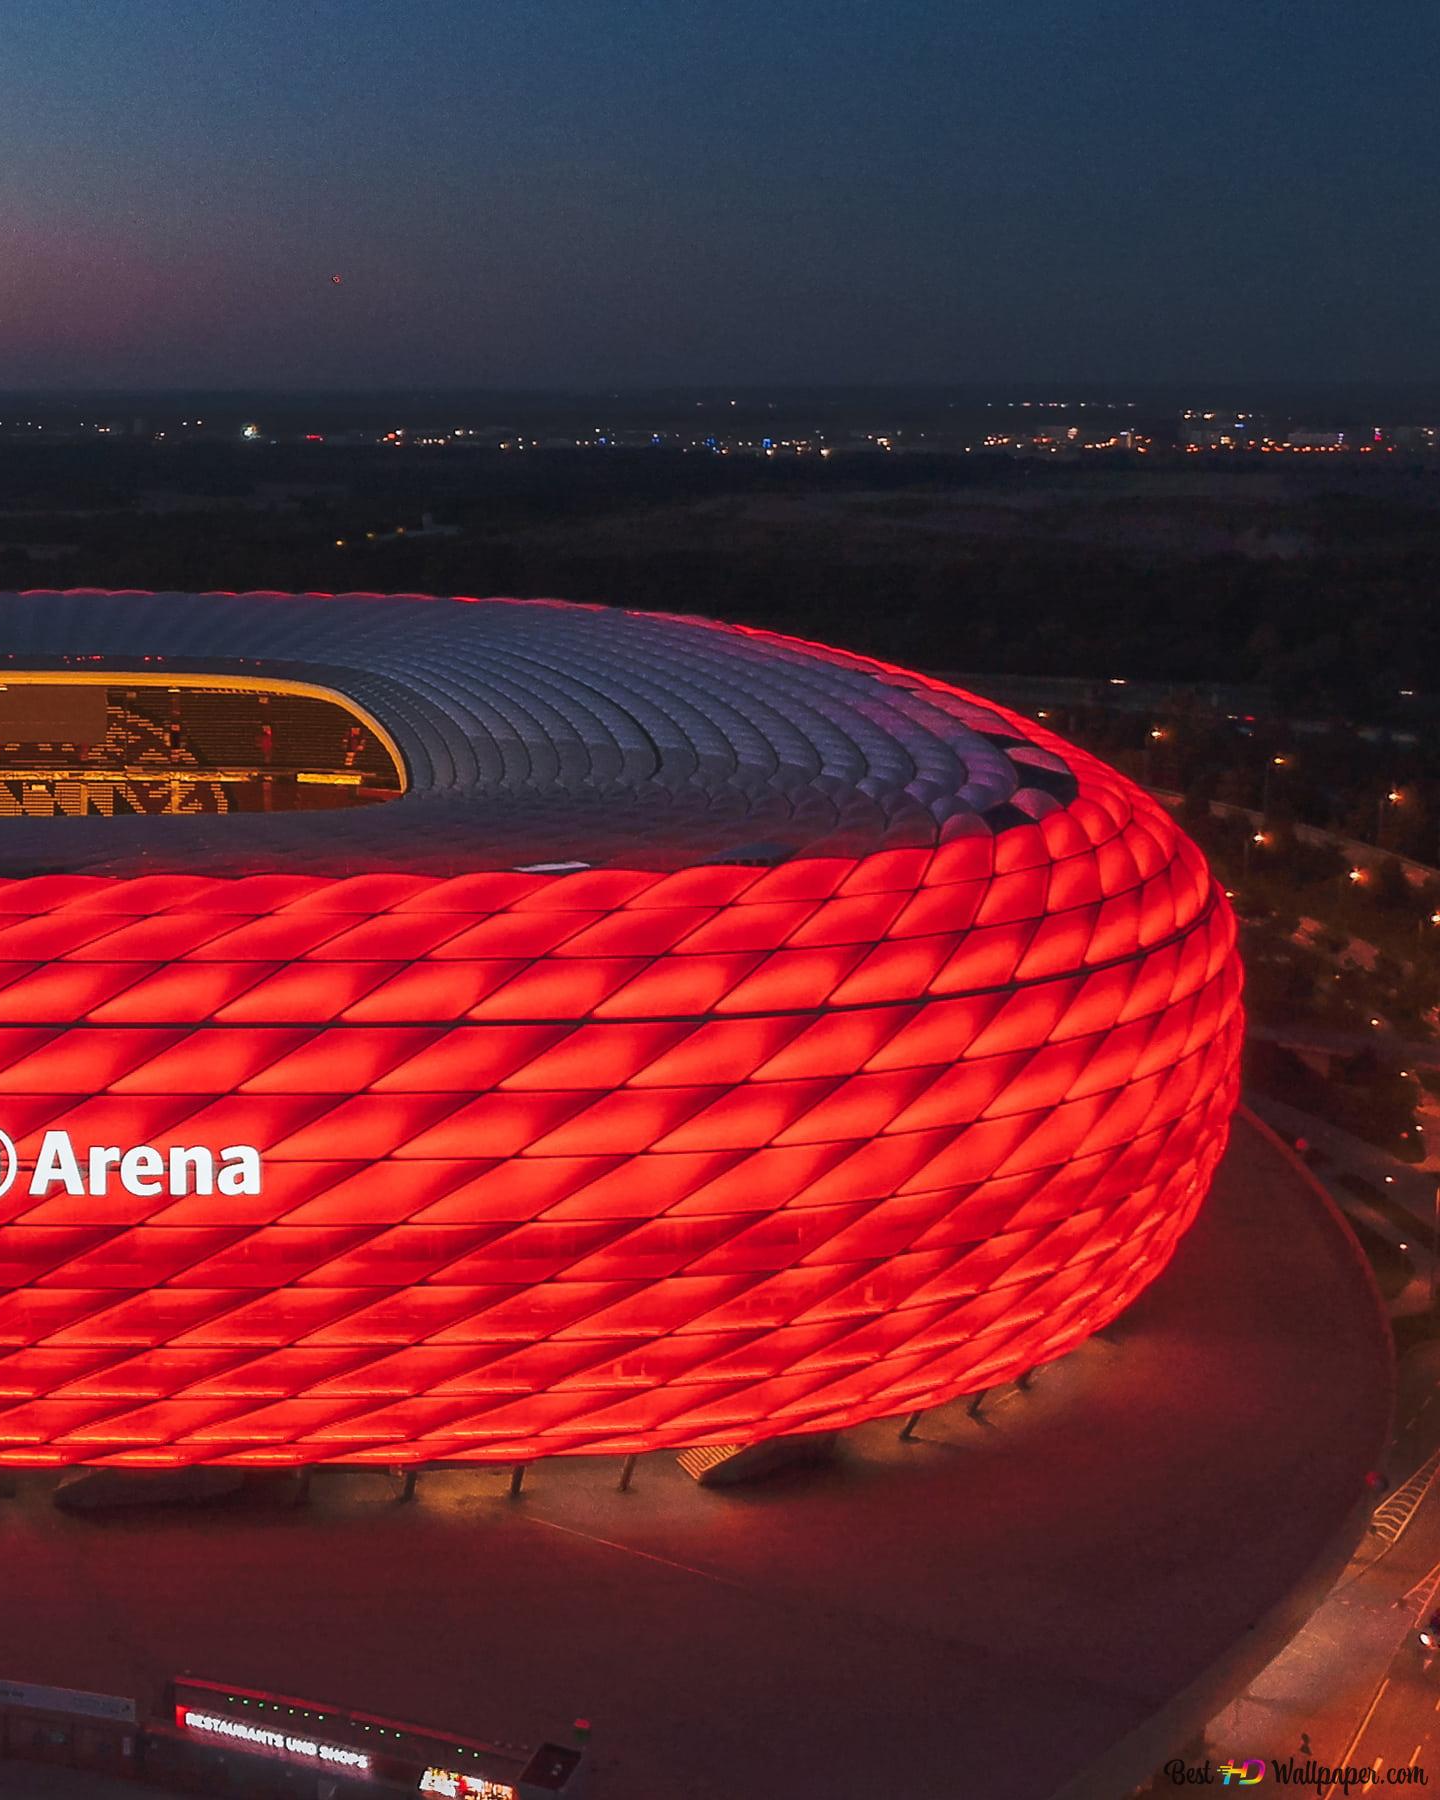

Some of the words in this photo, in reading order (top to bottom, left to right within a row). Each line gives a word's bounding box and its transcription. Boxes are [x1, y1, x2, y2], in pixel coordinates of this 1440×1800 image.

[29, 1130, 261, 1196] Arena
[185, 1712, 285, 1748] RESTAURANTS
[286, 1737, 318, 1756] UND
[319, 1746, 369, 1769] SHOPS
